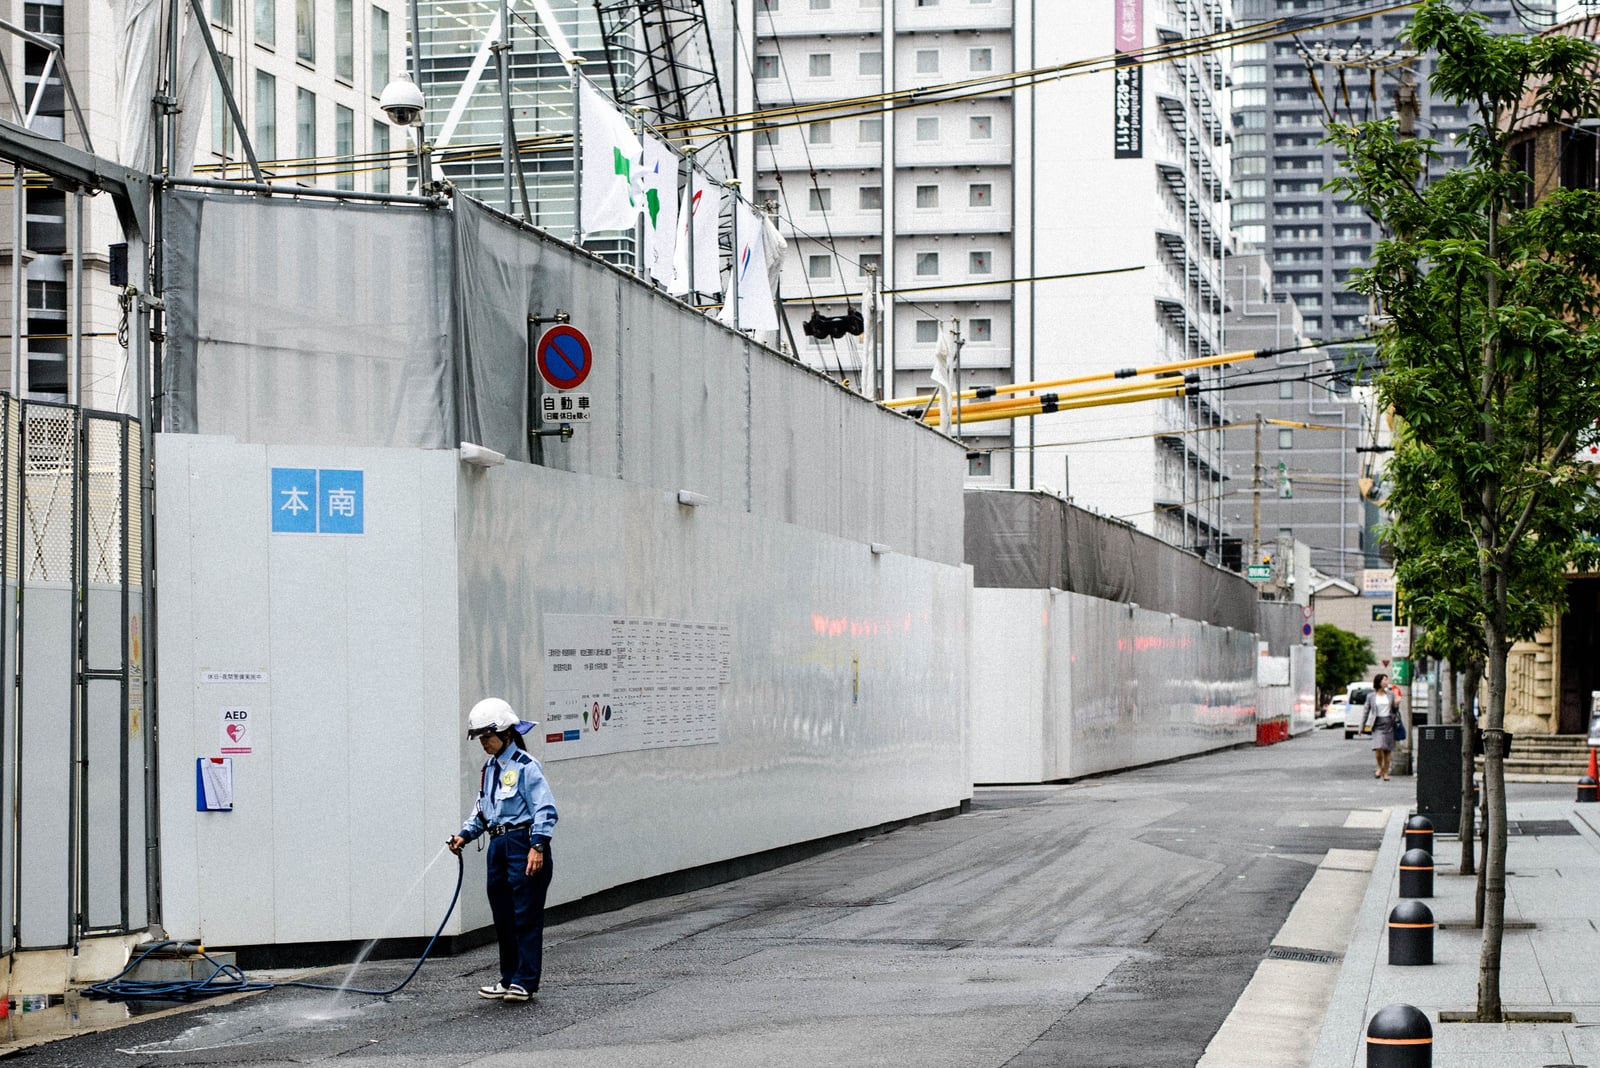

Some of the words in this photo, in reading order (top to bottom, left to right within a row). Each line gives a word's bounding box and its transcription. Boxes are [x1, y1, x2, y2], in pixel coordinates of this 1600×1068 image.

[544, 396, 590, 410] 自動車
[280, 487, 309, 516] 本
[328, 488, 356, 517] 南
[224, 711, 248, 720] AED
